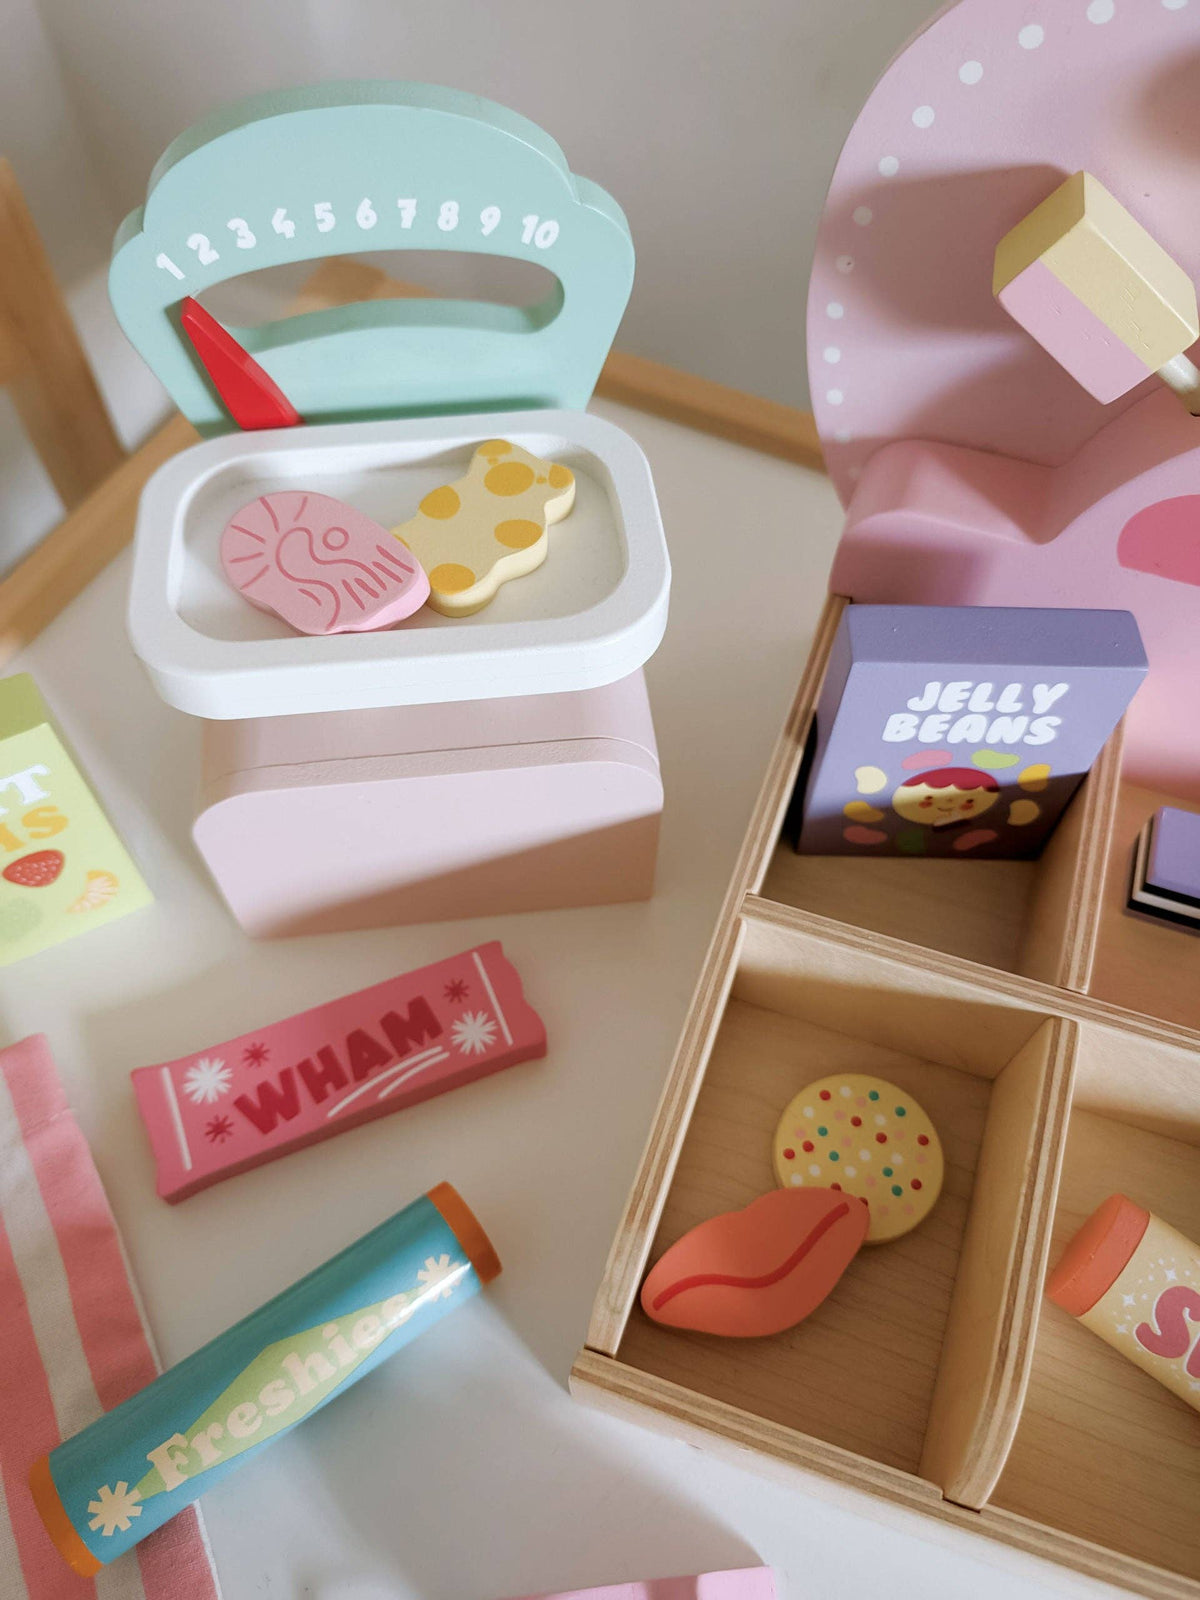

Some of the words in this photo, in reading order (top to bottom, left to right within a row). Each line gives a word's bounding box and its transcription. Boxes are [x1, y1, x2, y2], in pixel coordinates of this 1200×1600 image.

[155, 252, 186, 281] 1
[187, 233, 220, 266] 2
[226, 218, 257, 250] 3
[271, 208, 297, 239] 4
[314, 202, 336, 233] 5
[356, 197, 378, 230] 6
[397, 198, 418, 229] 7
[437, 200, 460, 232] 8
[479, 206, 502, 237] 9
[521, 214, 561, 250] 10
[881, 713, 1062, 745] BEANS
[907, 682, 1069, 713] JELLY
[233, 995, 444, 1135] WHAM
[147, 1292, 418, 1492] Freshies
